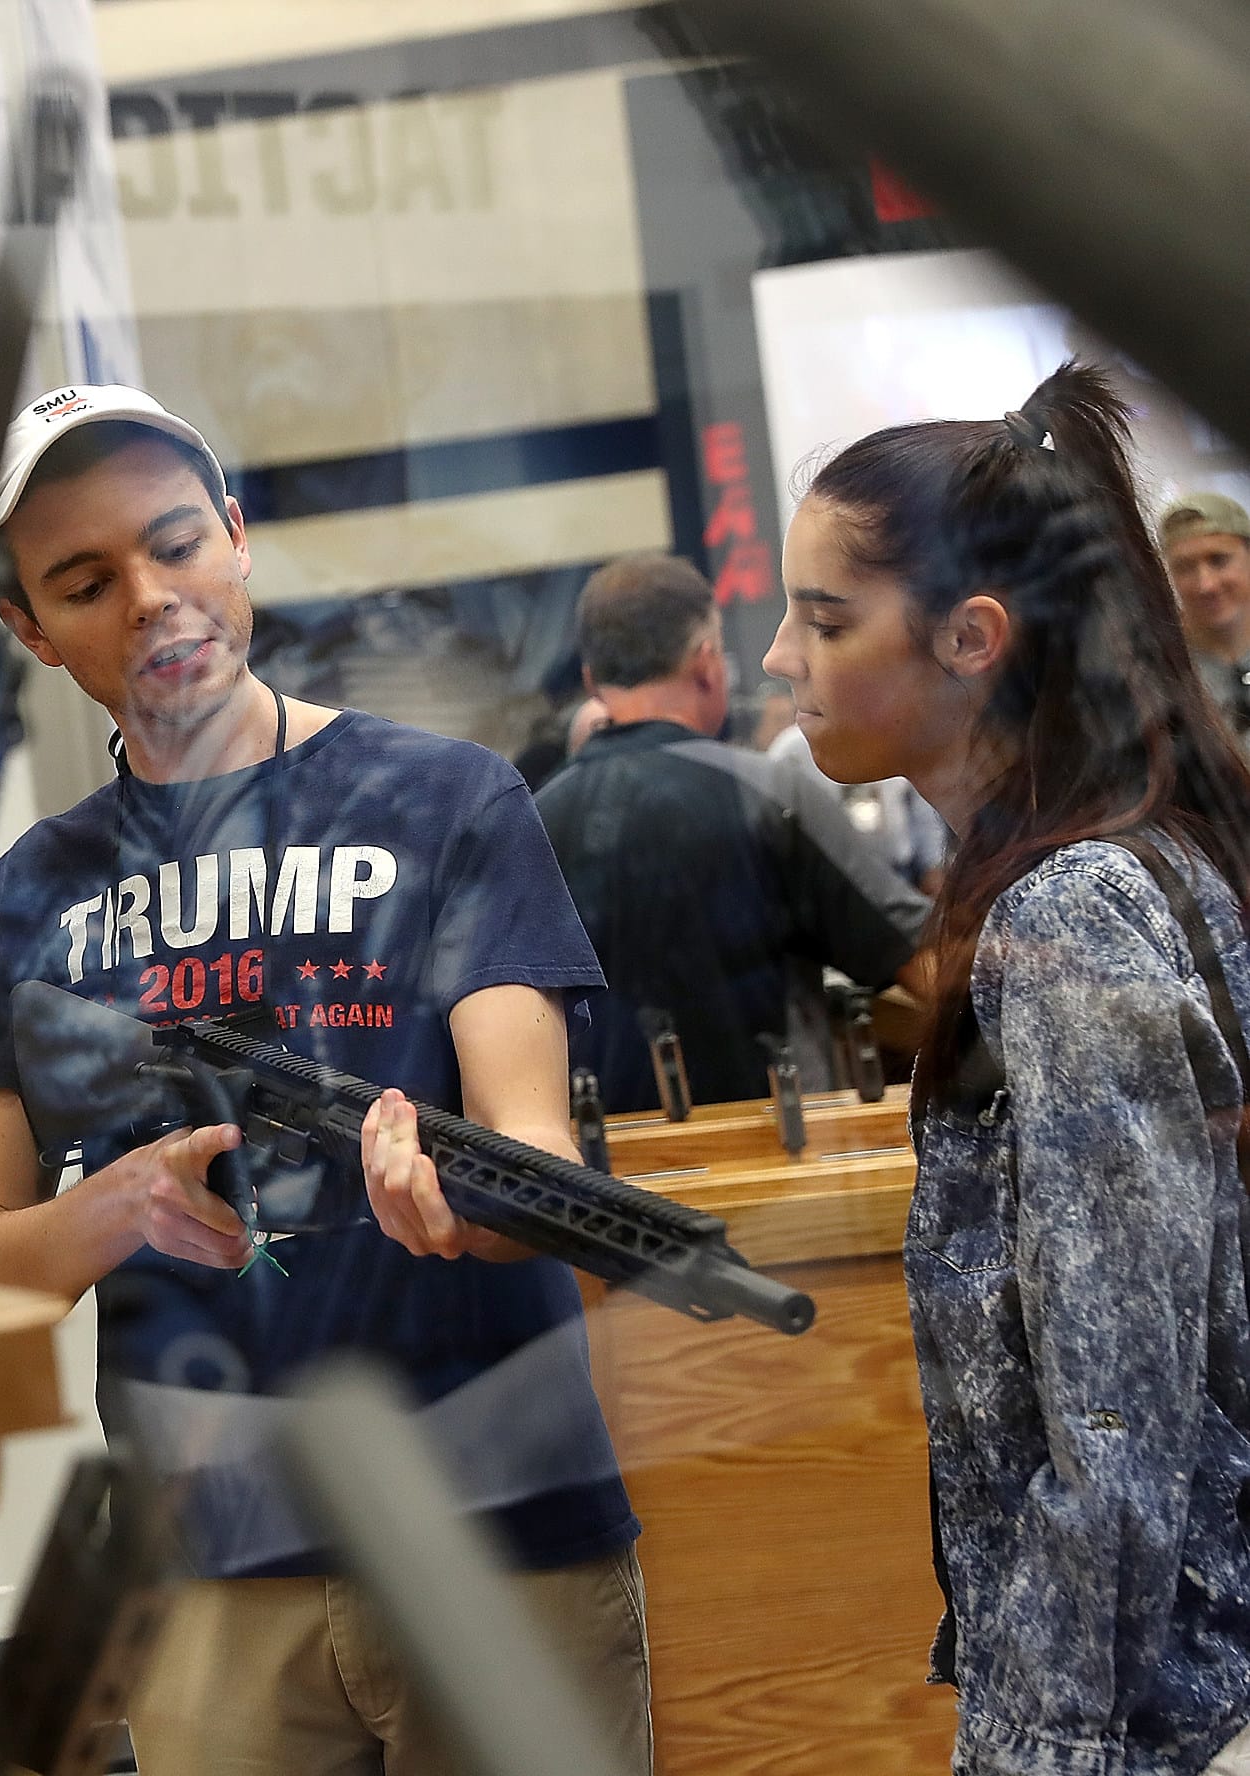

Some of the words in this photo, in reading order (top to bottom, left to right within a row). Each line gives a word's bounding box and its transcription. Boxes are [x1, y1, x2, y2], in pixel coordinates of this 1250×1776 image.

[33, 389, 77, 415] SMU
[59, 845, 398, 984] TRUMP
[138, 949, 264, 1014] 2016
[310, 1003, 393, 1028] AGAIN
